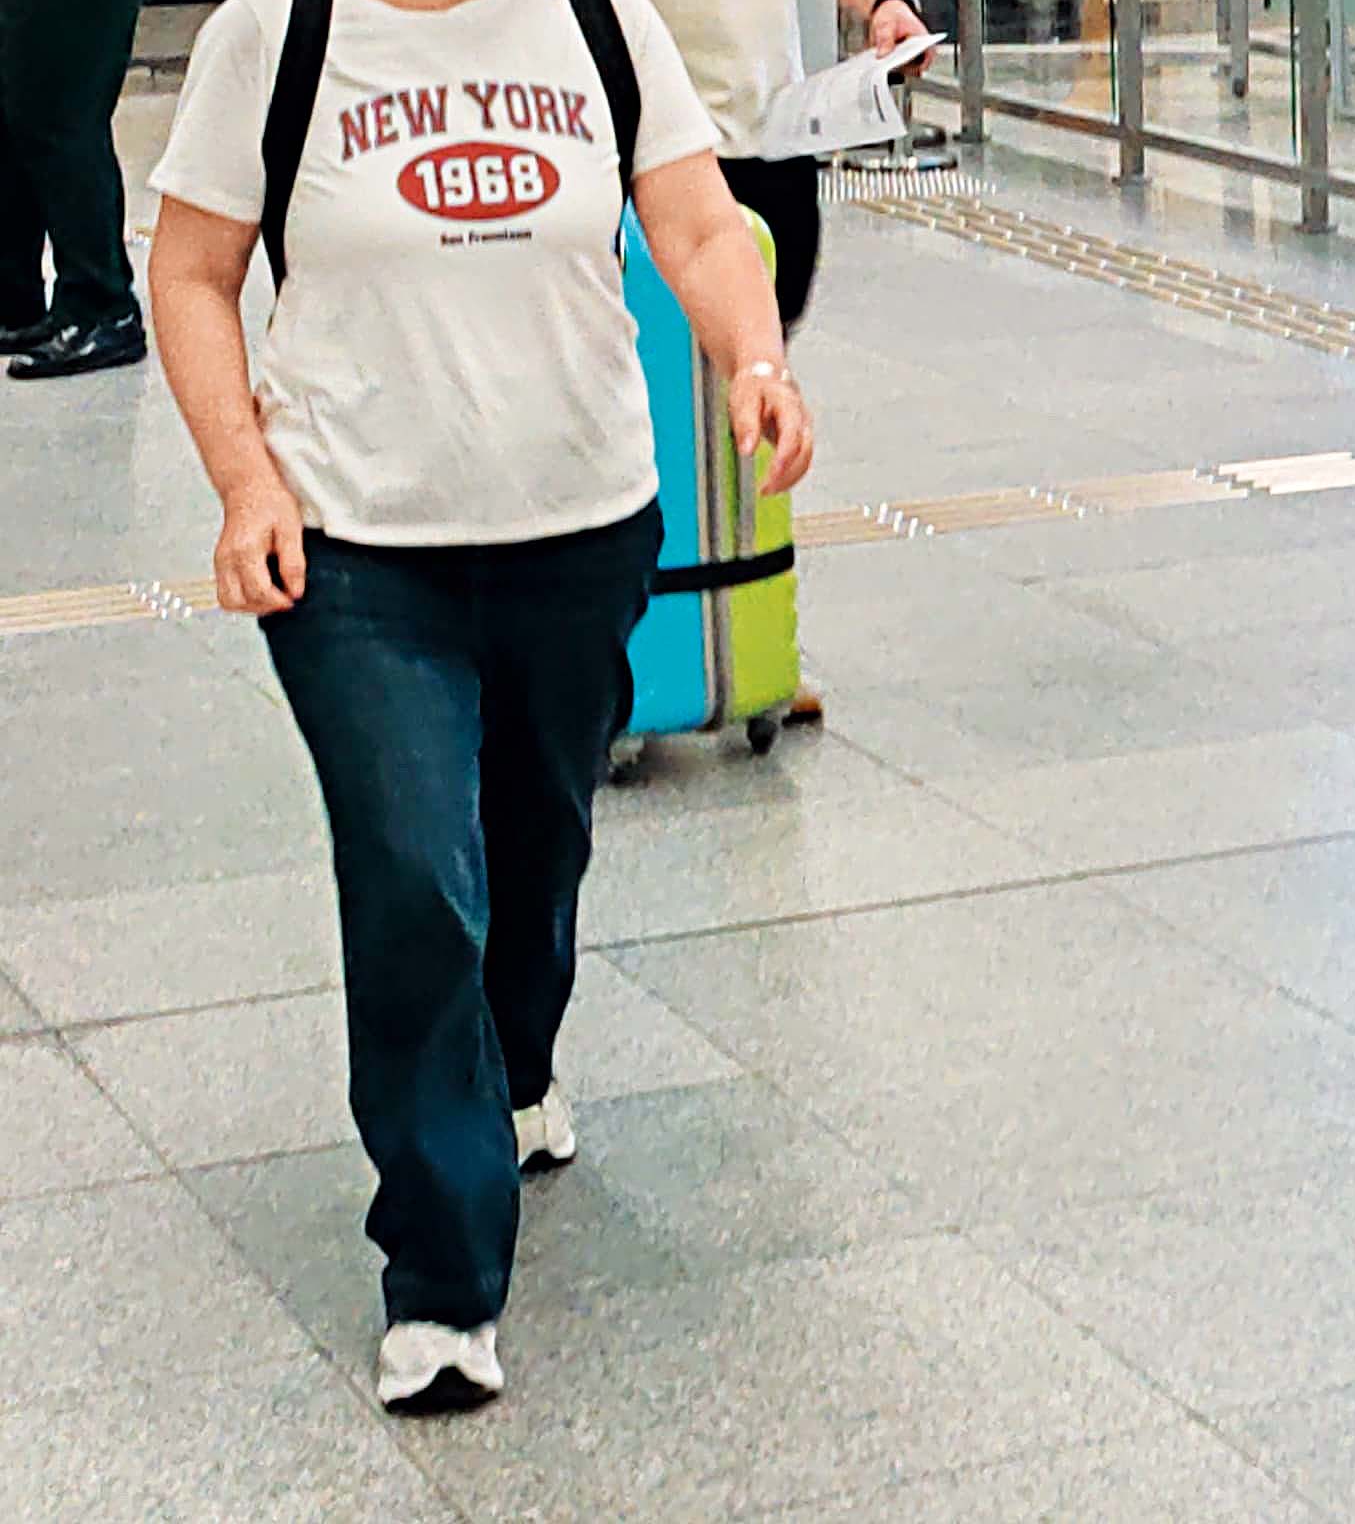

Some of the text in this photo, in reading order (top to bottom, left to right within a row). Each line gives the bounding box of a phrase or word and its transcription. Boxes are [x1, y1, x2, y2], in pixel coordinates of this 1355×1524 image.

[338, 82, 594, 162] NEW YORK
[415, 154, 545, 211] 1968
